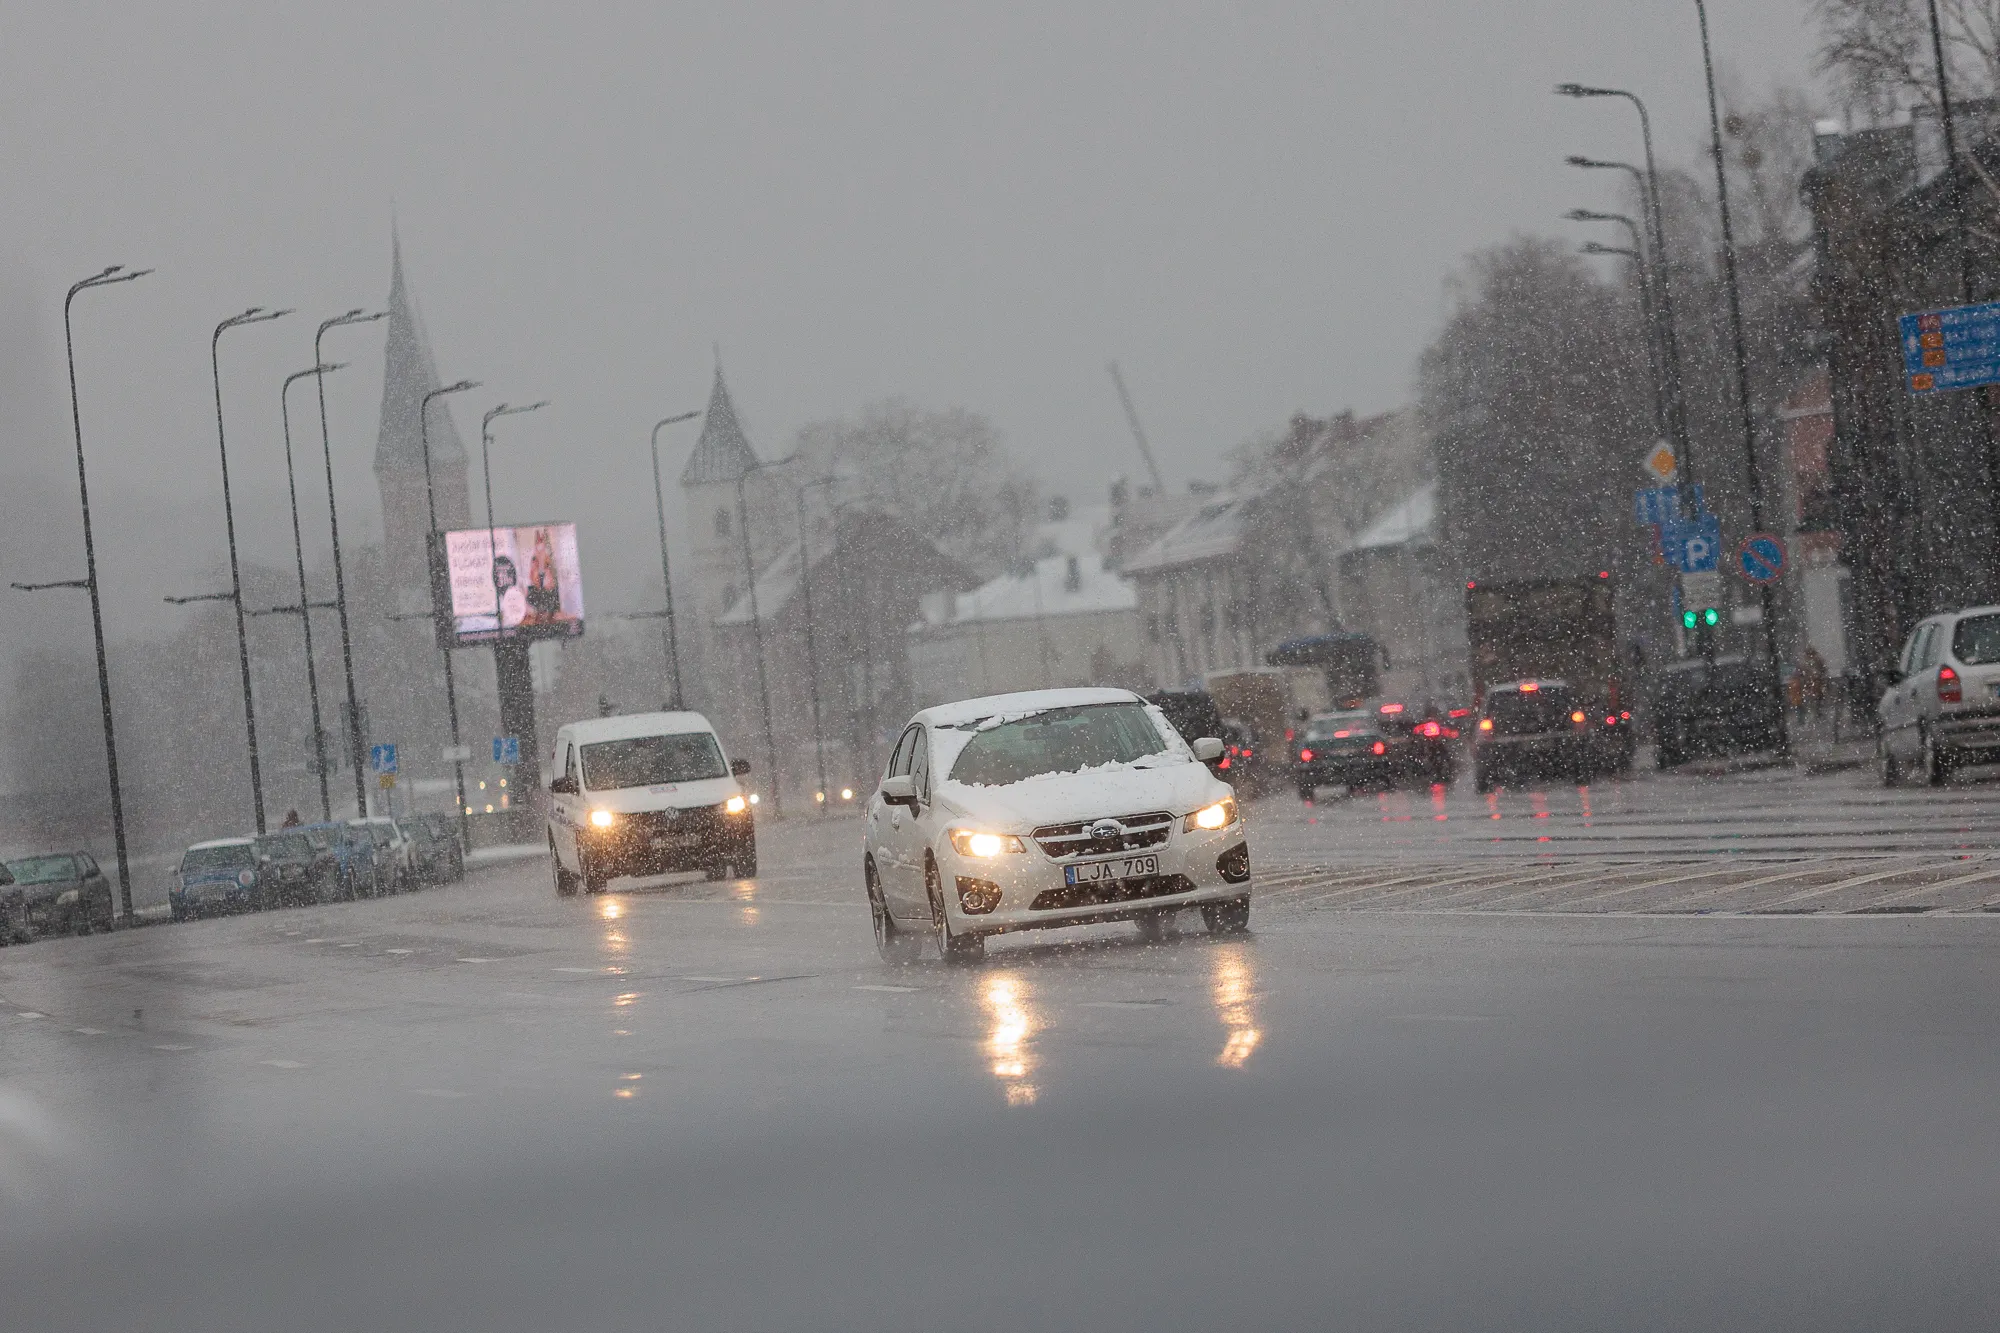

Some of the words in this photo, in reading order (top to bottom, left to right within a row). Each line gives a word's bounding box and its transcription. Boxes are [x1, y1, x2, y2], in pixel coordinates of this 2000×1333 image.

[1687, 538, 1709, 568] P
[1076, 864, 1113, 882] LJA
[1124, 858, 1155, 876] 709
